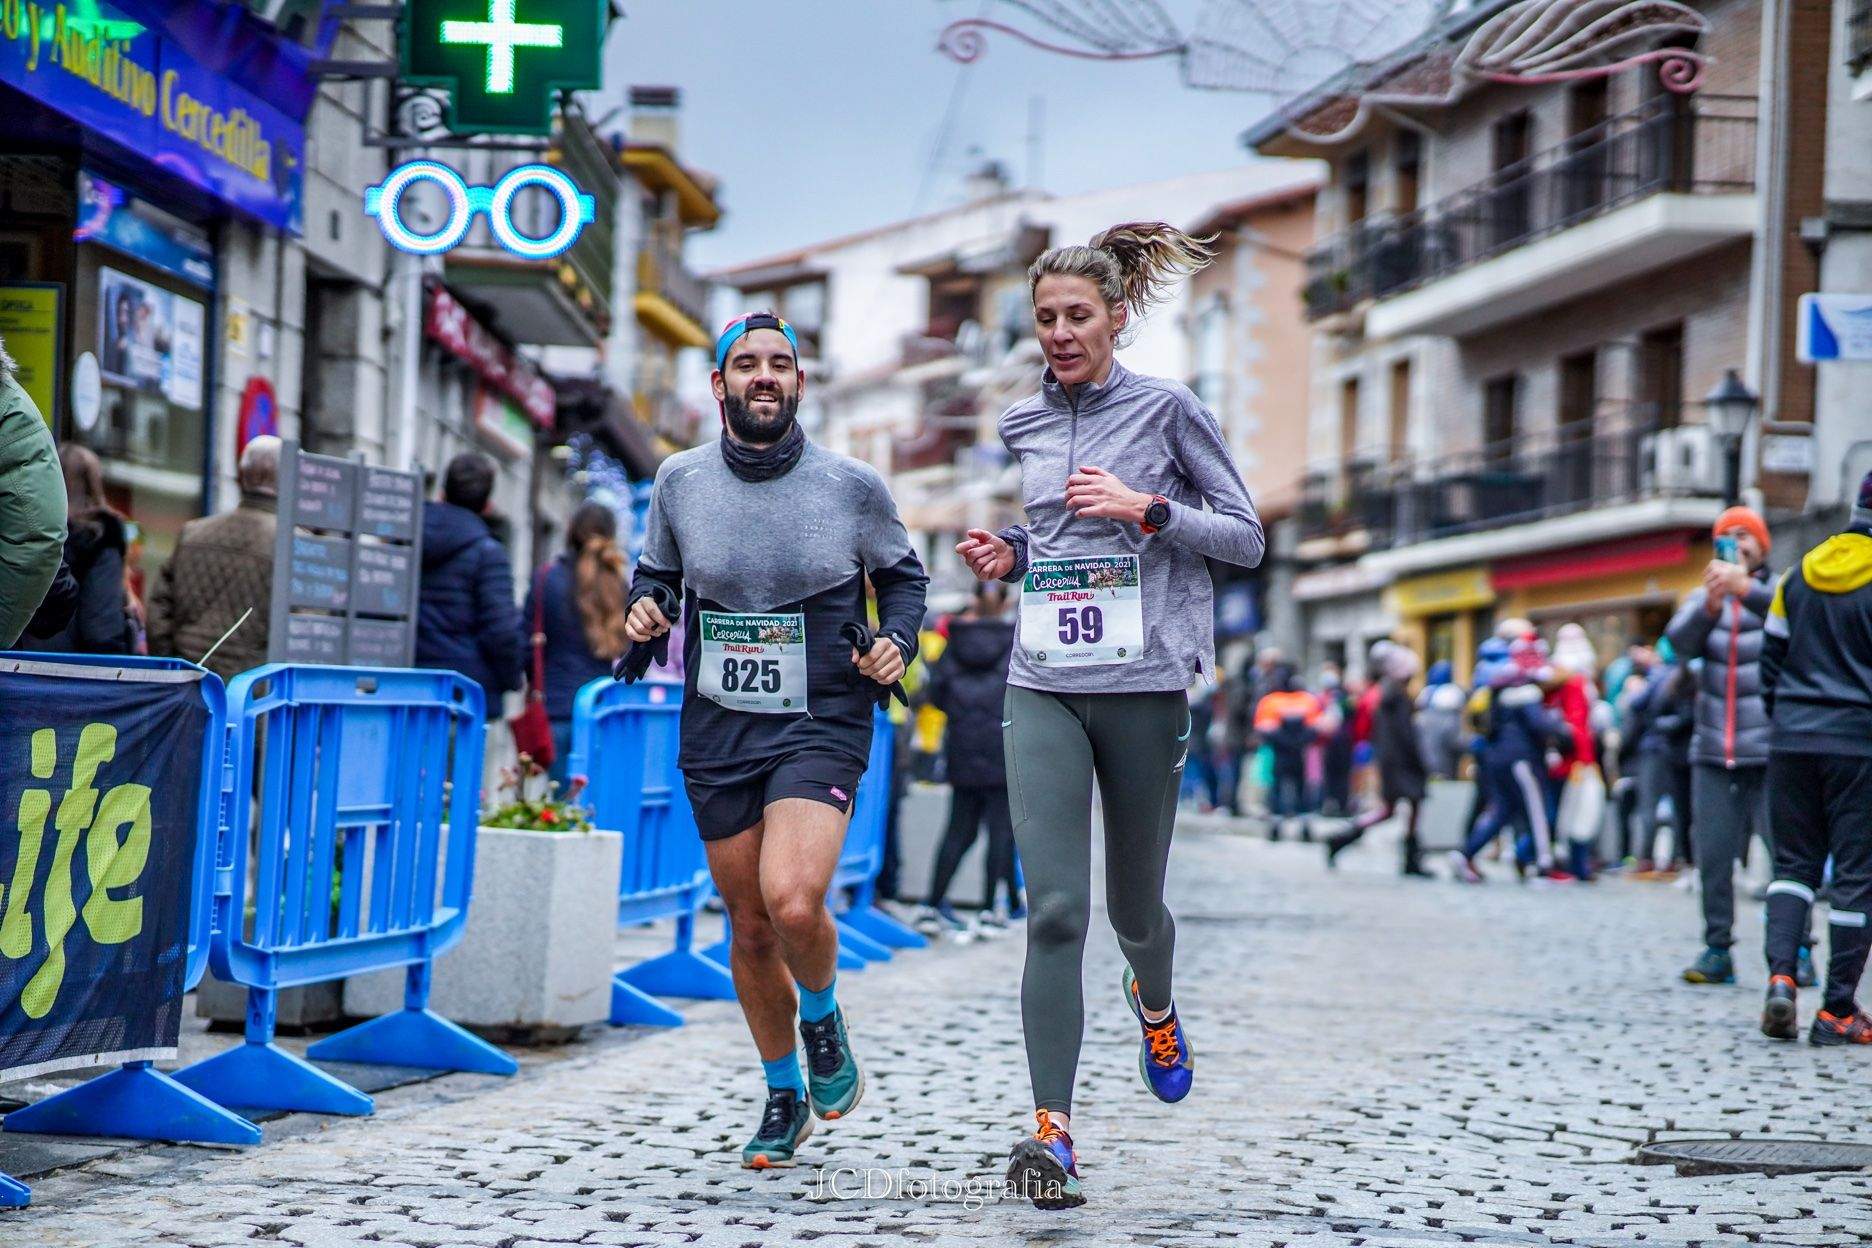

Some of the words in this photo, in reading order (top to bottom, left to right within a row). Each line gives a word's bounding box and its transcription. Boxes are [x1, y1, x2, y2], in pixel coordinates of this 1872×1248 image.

[158, 68, 271, 182] Cercedilla
[1029, 565, 1062, 573] CARRERA
[1075, 562, 1111, 570] NAVIDAD
[1047, 592, 1071, 602] Trail
[706, 617, 735, 626] CARRERA
[745, 619, 780, 627] NAVIDAD
[1058, 605, 1104, 645] 59
[721, 657, 781, 694] 825
[0, 722, 152, 1020] ife
